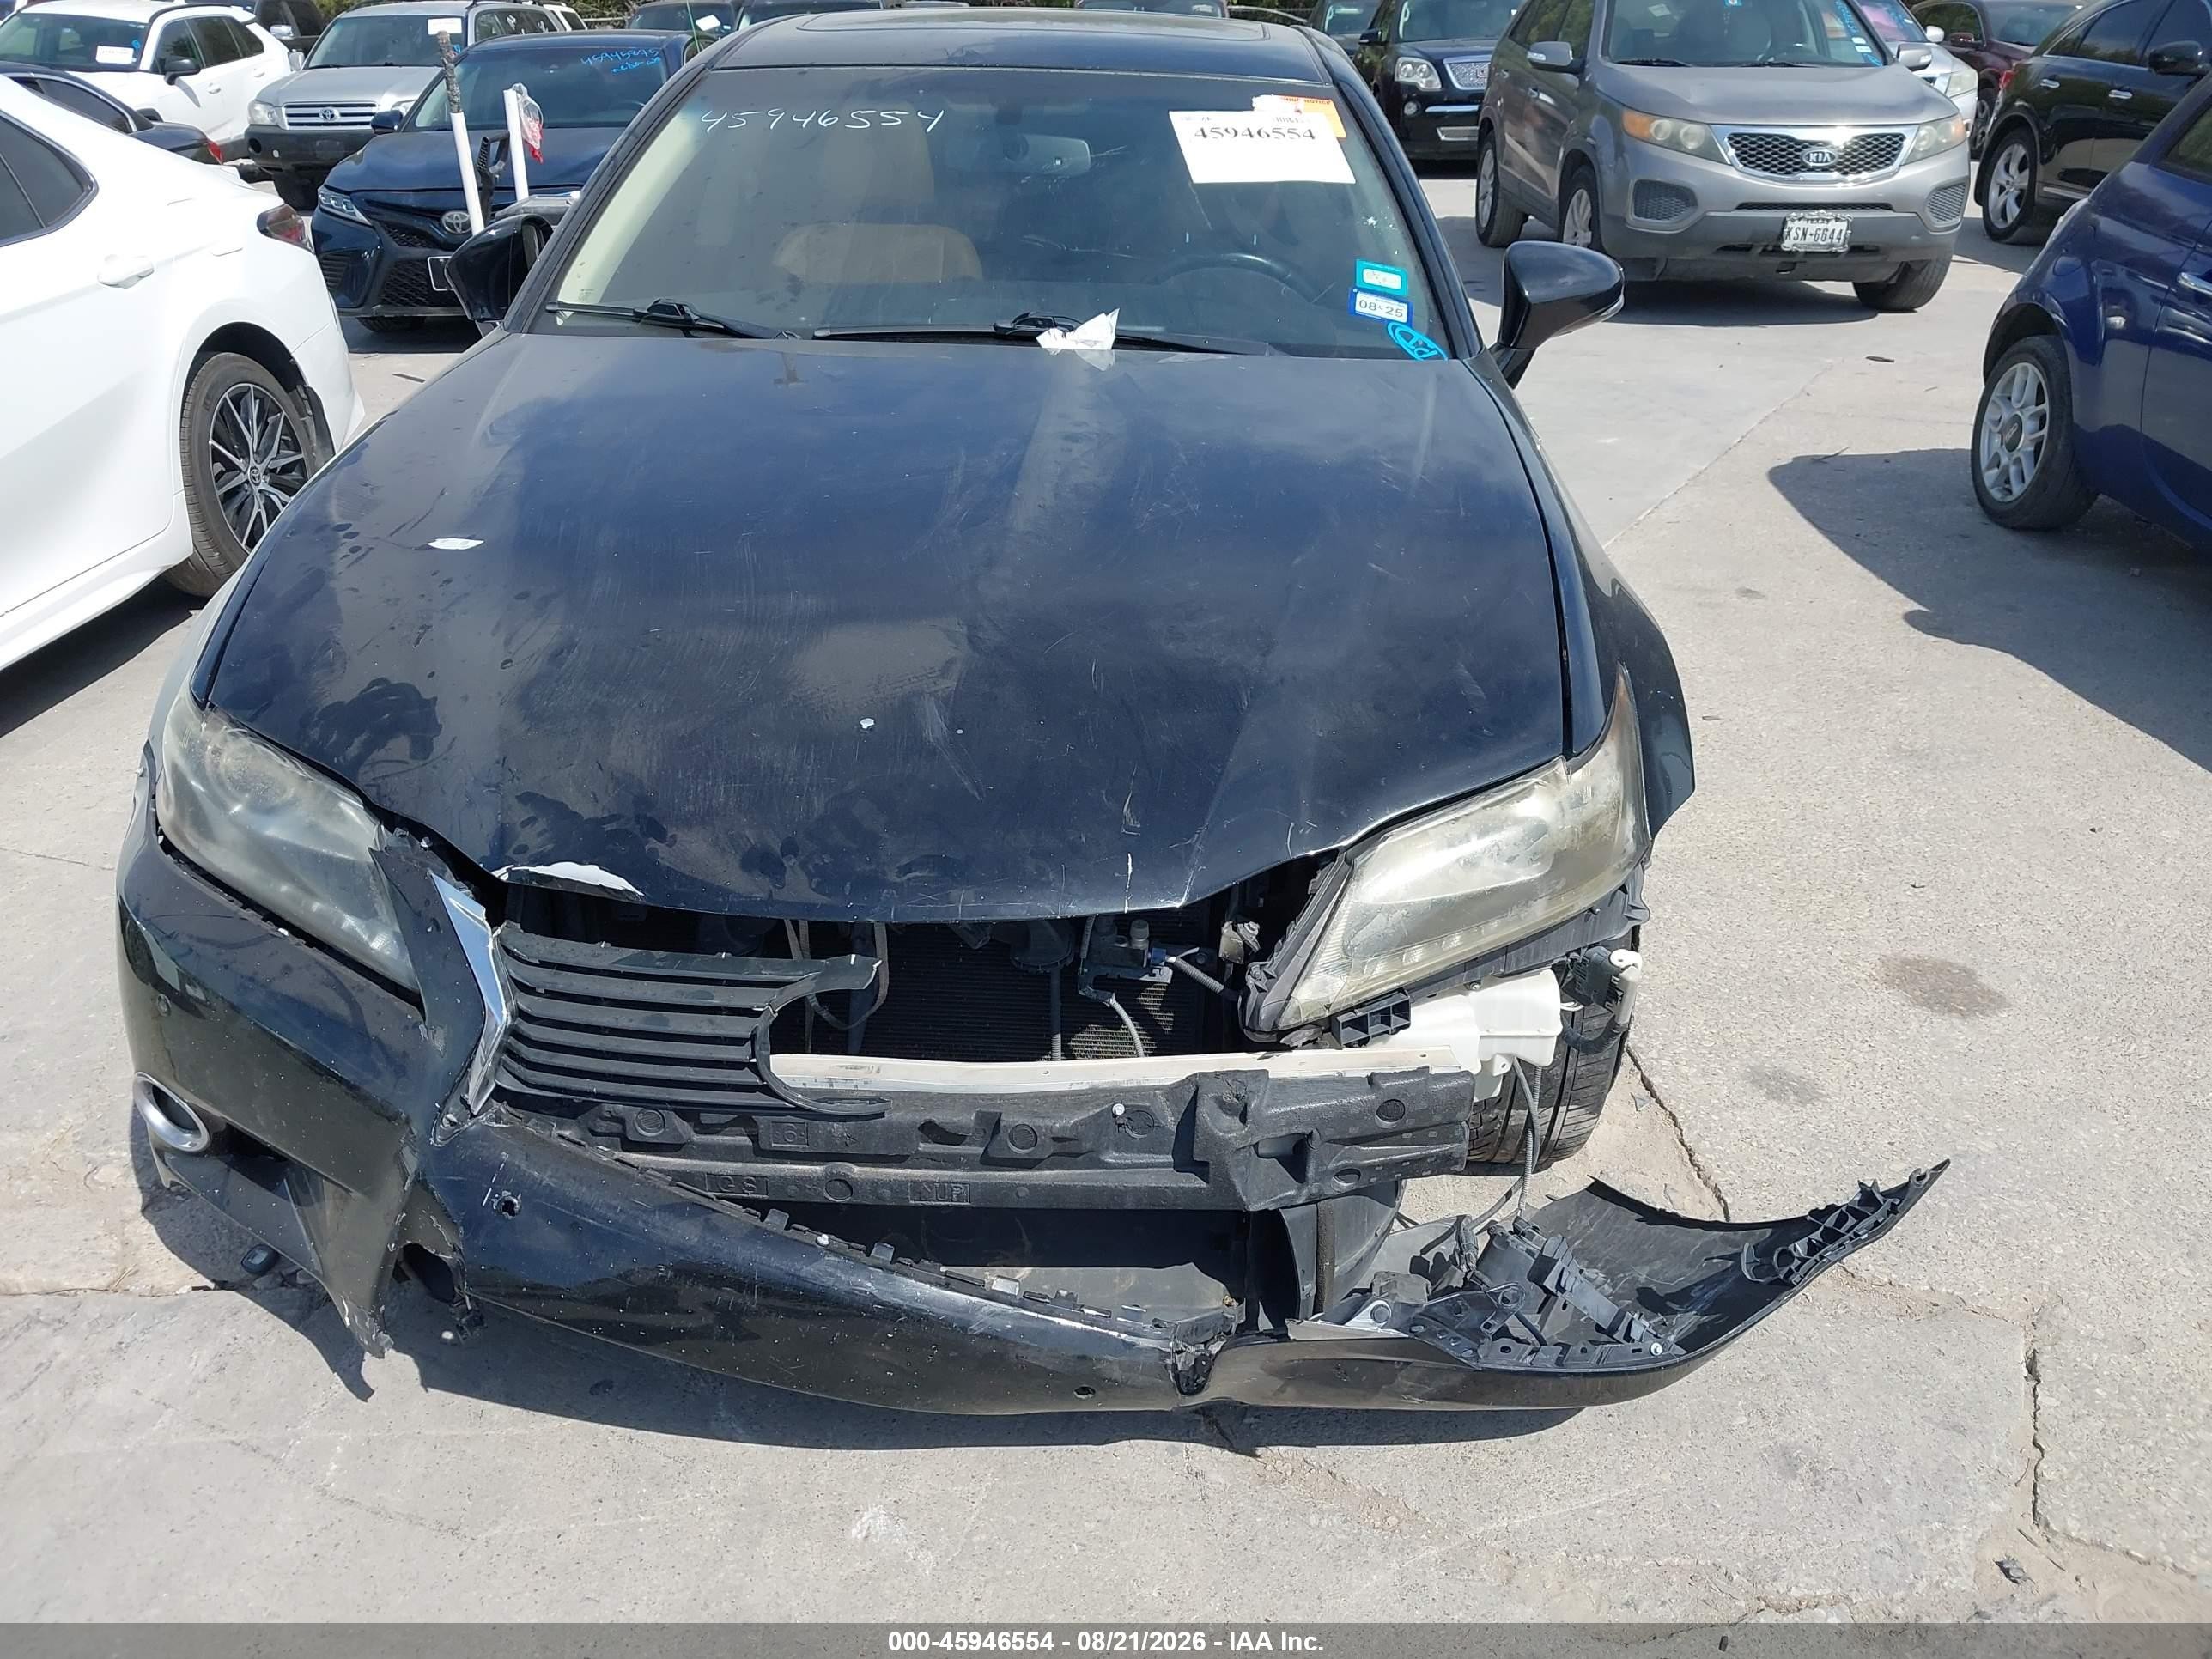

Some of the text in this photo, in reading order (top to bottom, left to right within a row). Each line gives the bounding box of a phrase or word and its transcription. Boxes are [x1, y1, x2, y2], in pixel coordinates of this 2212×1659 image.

[701, 108, 945, 133] 45946554
[1194, 126, 1316, 140] 45946554
[1808, 152, 1832, 162] KIA
[1358, 299, 1377, 311] 08
[1384, 305, 1404, 318] 25
